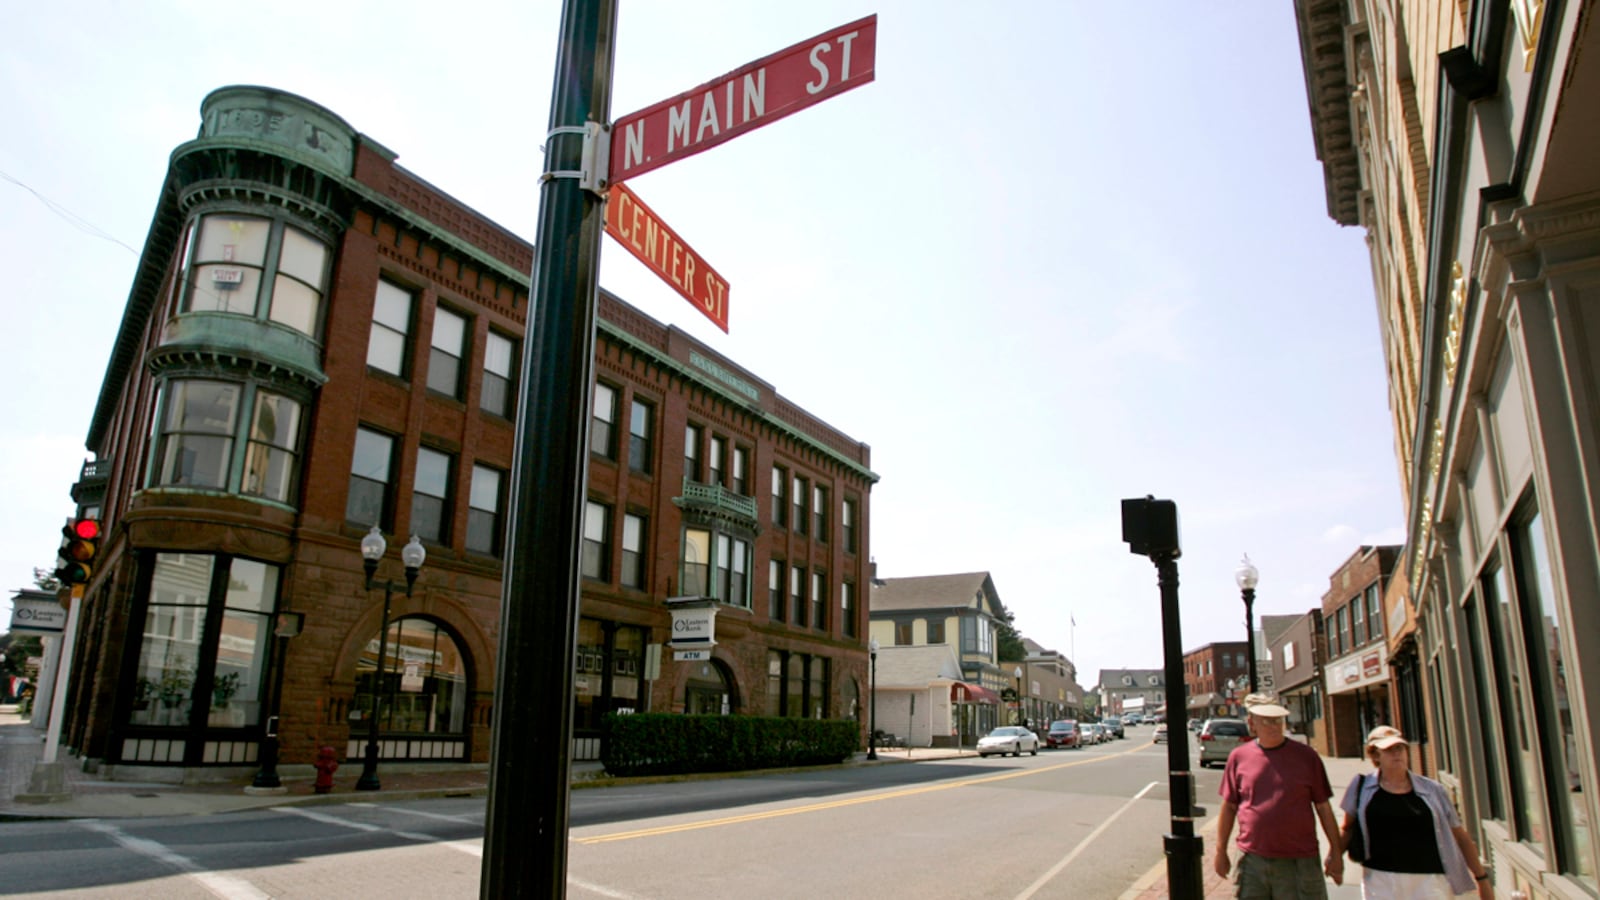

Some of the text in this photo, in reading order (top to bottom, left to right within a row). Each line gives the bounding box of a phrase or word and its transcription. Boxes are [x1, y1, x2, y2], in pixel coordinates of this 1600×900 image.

[623, 31, 858, 170] N. MAIN ST
[618, 192, 725, 320] CENTER ST
